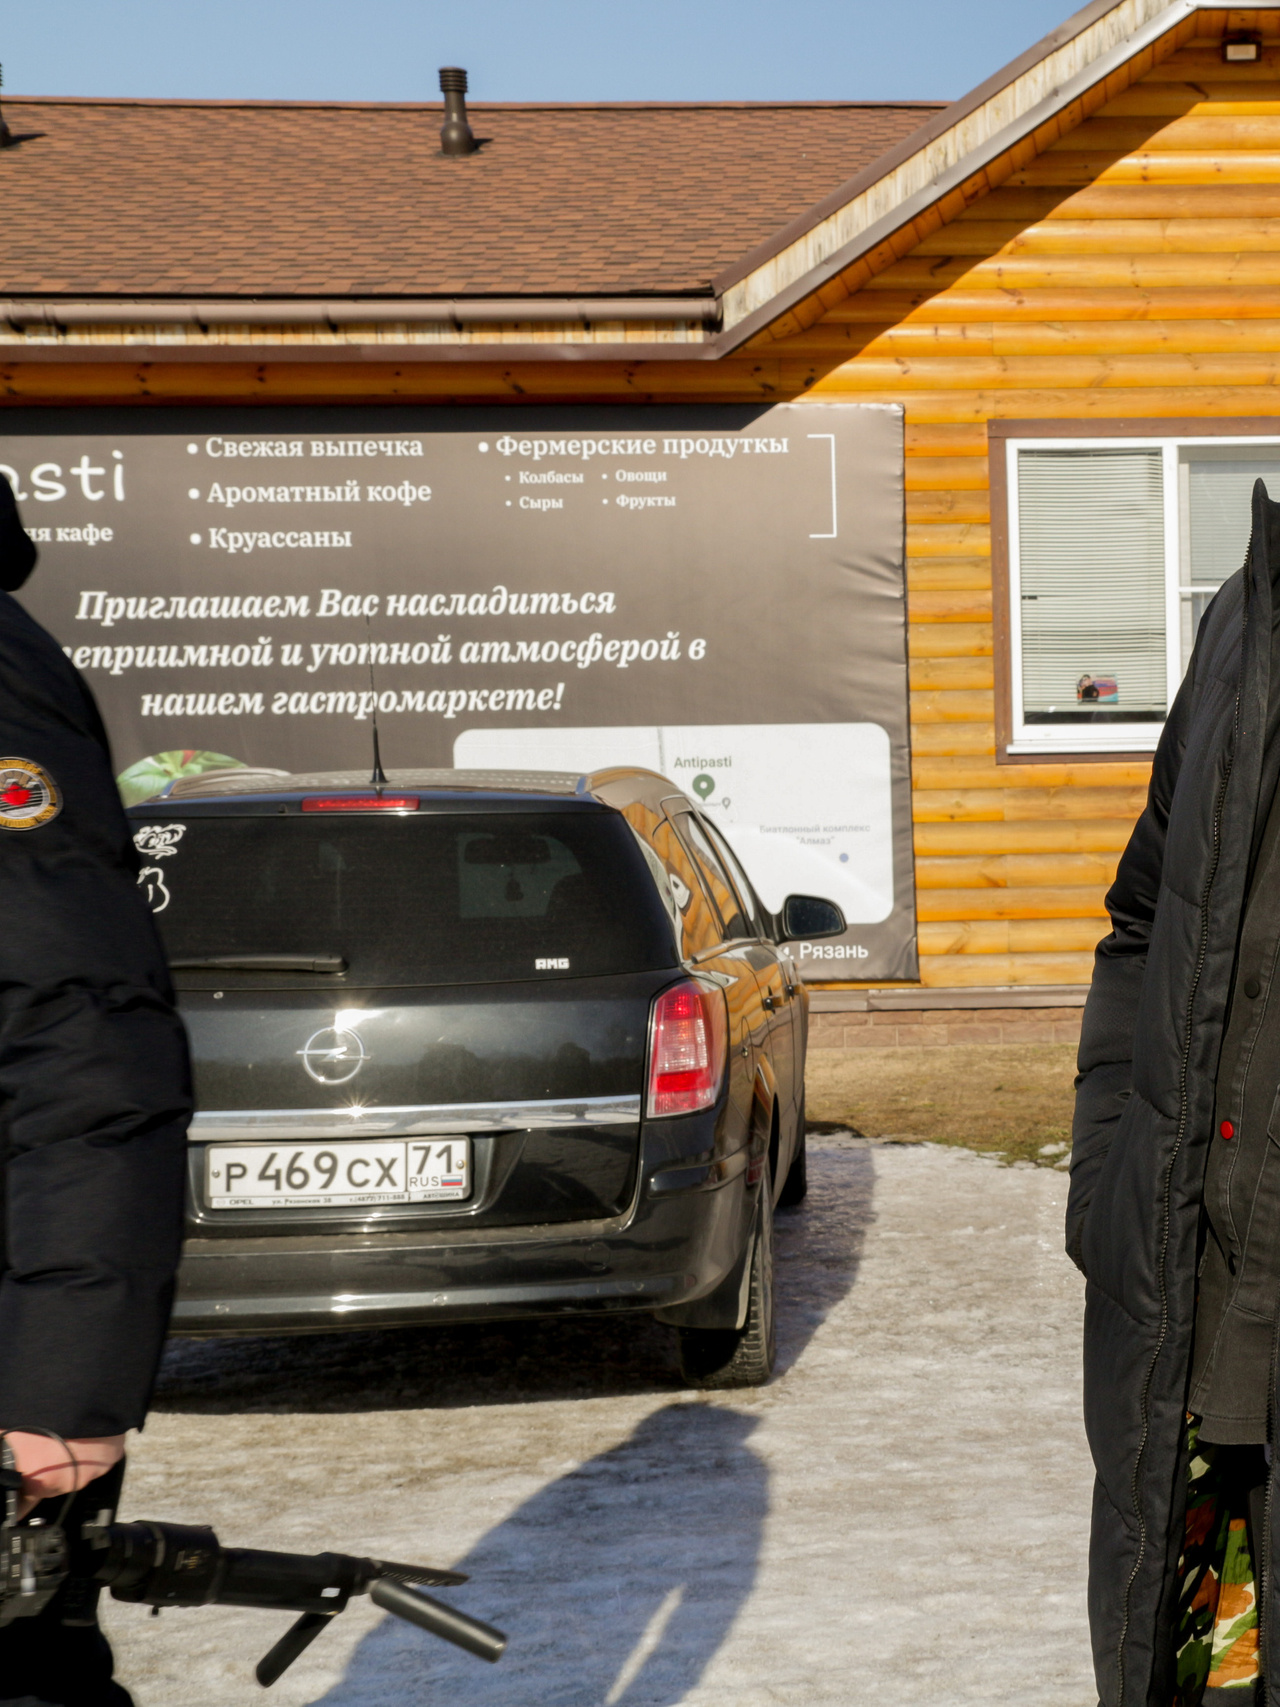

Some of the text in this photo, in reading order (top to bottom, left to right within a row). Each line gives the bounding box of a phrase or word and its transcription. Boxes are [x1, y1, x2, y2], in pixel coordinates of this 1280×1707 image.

[205, 437, 424, 458] Свежая выпечка
[495, 435, 790, 461] Фермерские продуткы
[519, 470, 584, 484] Колбасы
[615, 469, 667, 483] Овощи
[206, 480, 432, 508] Ароматный кофе
[615, 494, 676, 510] Фрукты
[519, 496, 564, 512] Сыры
[55, 524, 114, 546] кафе
[208, 527, 352, 553] Круассаны
[75, 585, 616, 626] Приглашаем Вас насладиться
[63, 632, 707, 674] еприимной и уютной атмосферой в
[141, 683, 565, 720] нашем гастромаркете!
[673, 756, 732, 772] Antipasti
[759, 824, 871, 834] Биатлонный комплекс
[799, 942, 869, 960] Рязань
[535, 957, 570, 970] AMG
[412, 1144, 452, 1175] 71
[409, 1176, 439, 1187] RUS
